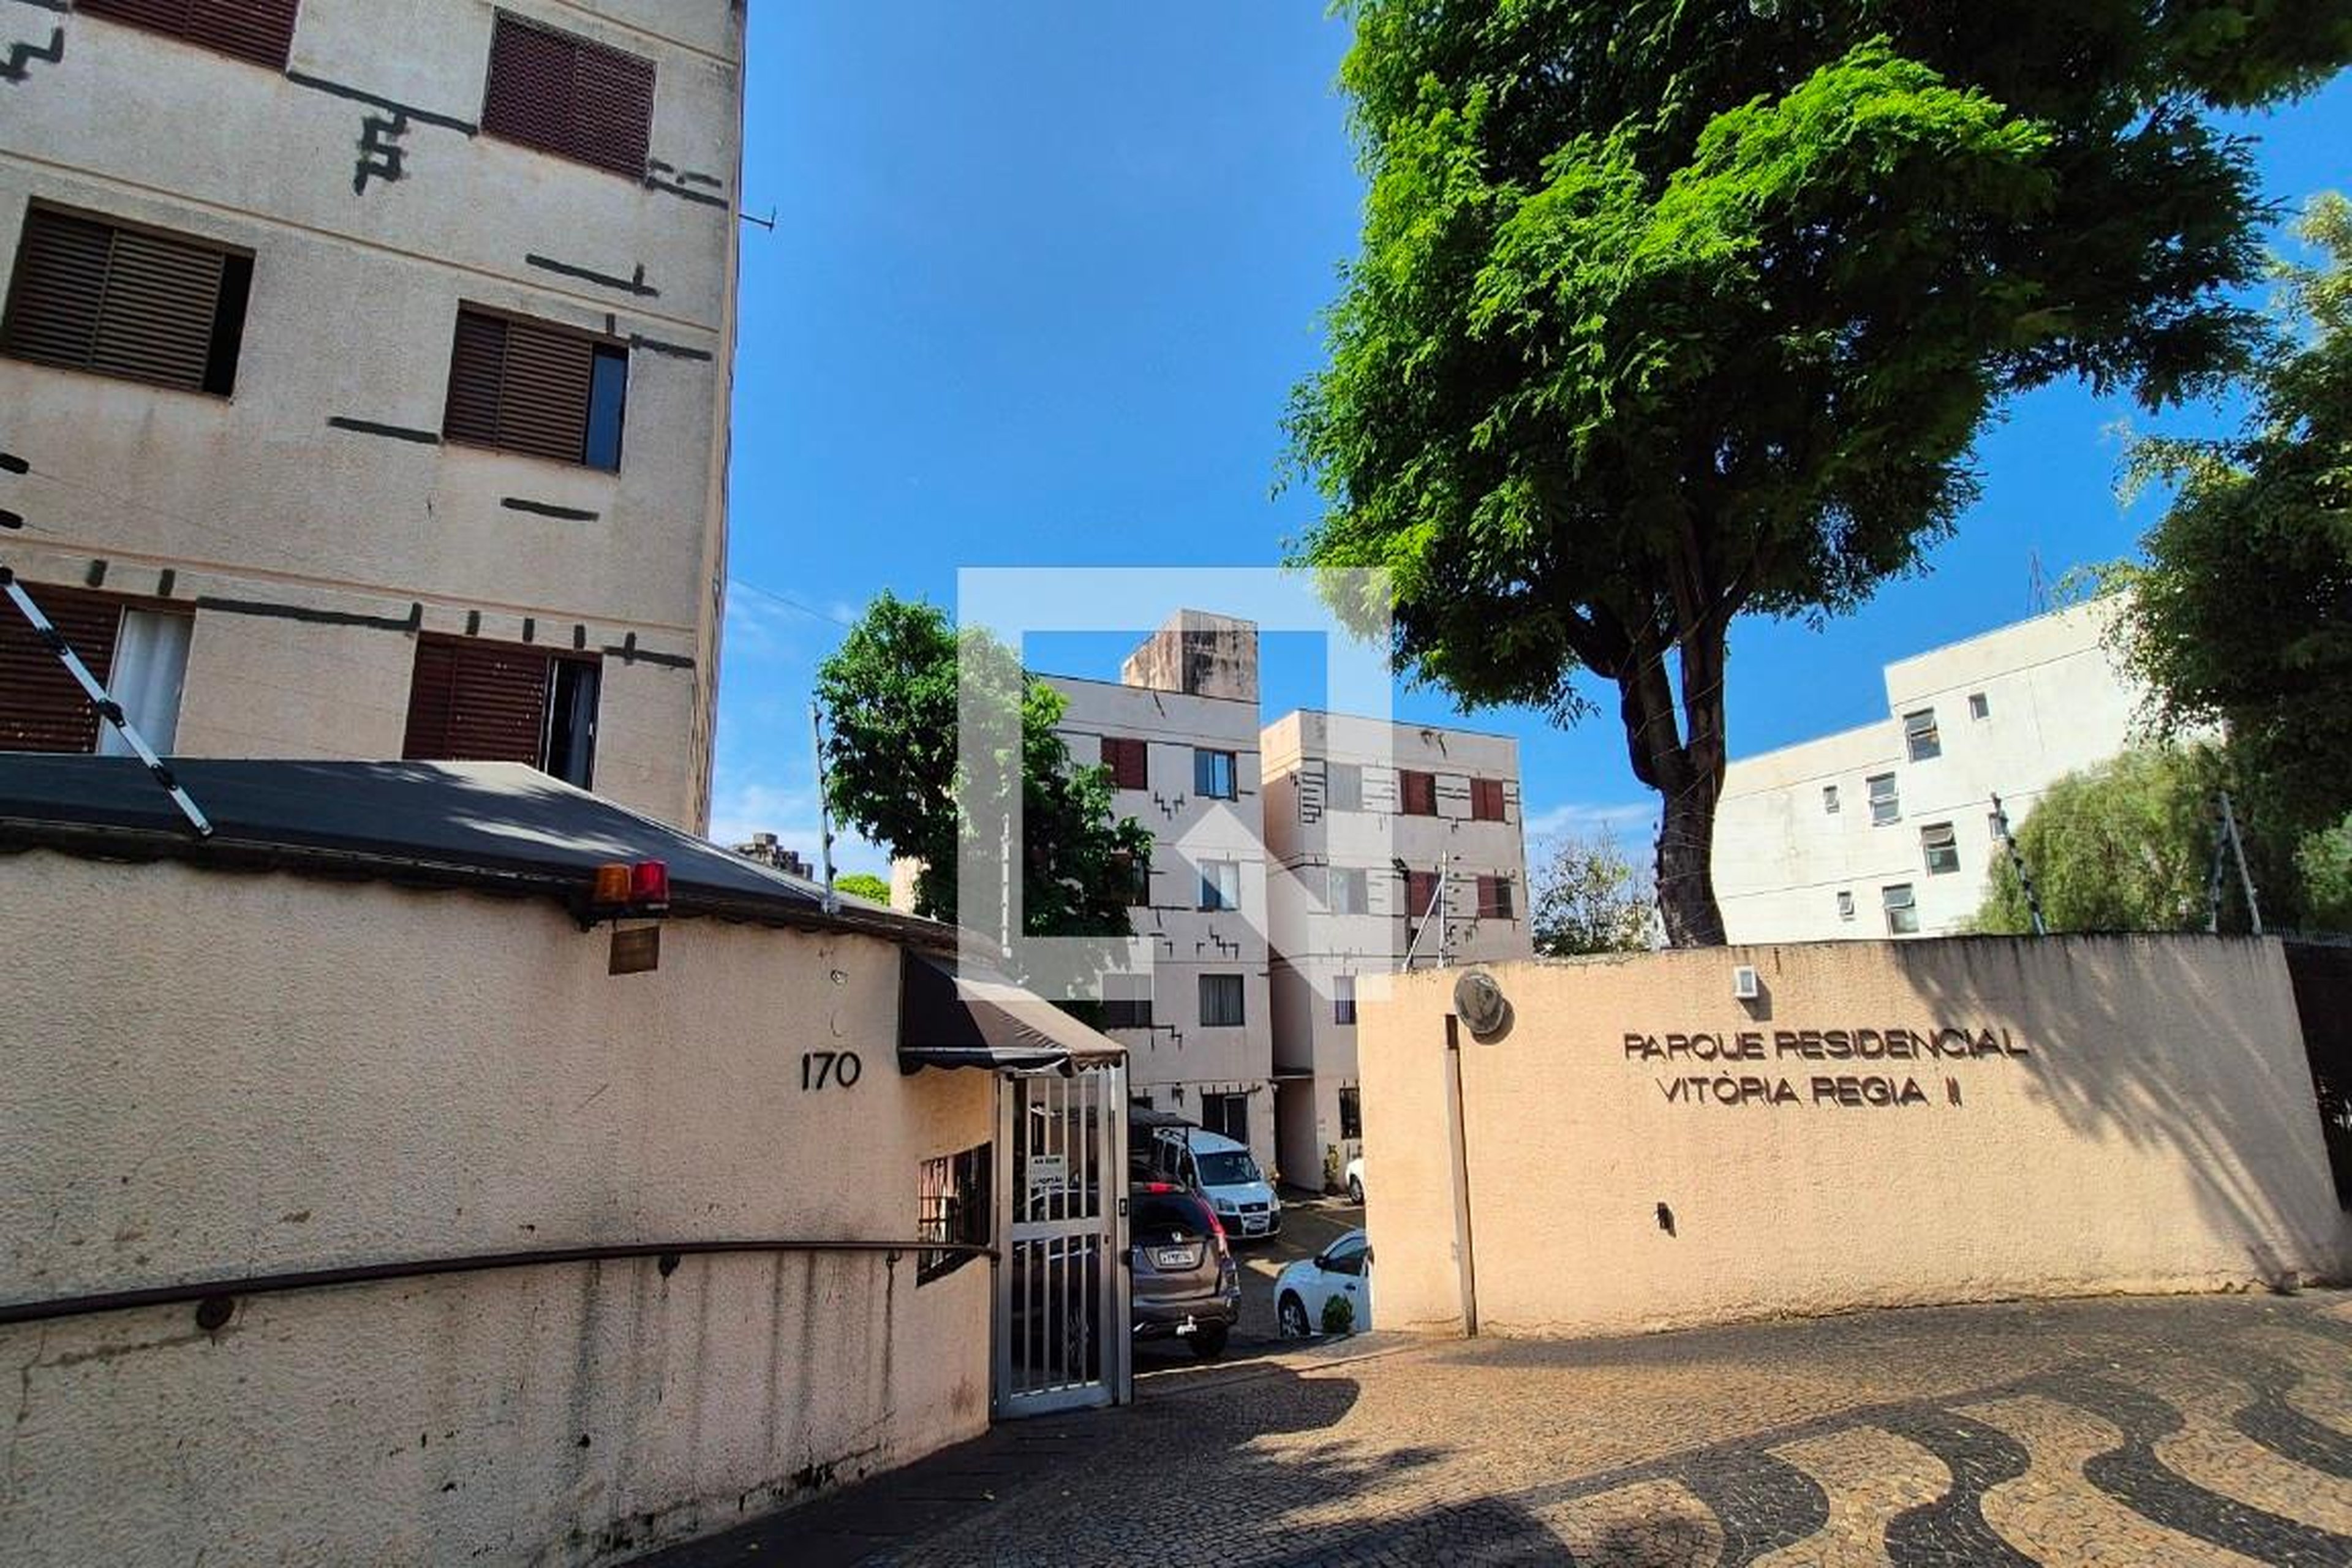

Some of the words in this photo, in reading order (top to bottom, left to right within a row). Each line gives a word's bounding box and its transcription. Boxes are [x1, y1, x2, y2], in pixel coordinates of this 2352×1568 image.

[1623, 1032, 1767, 1061] PARQUE
[1774, 1028, 2028, 1060] RESIDENCIAL
[802, 1052, 862, 1091] 170
[1811, 1076, 1930, 1107] REGIA
[1945, 1076, 1962, 1107] II
